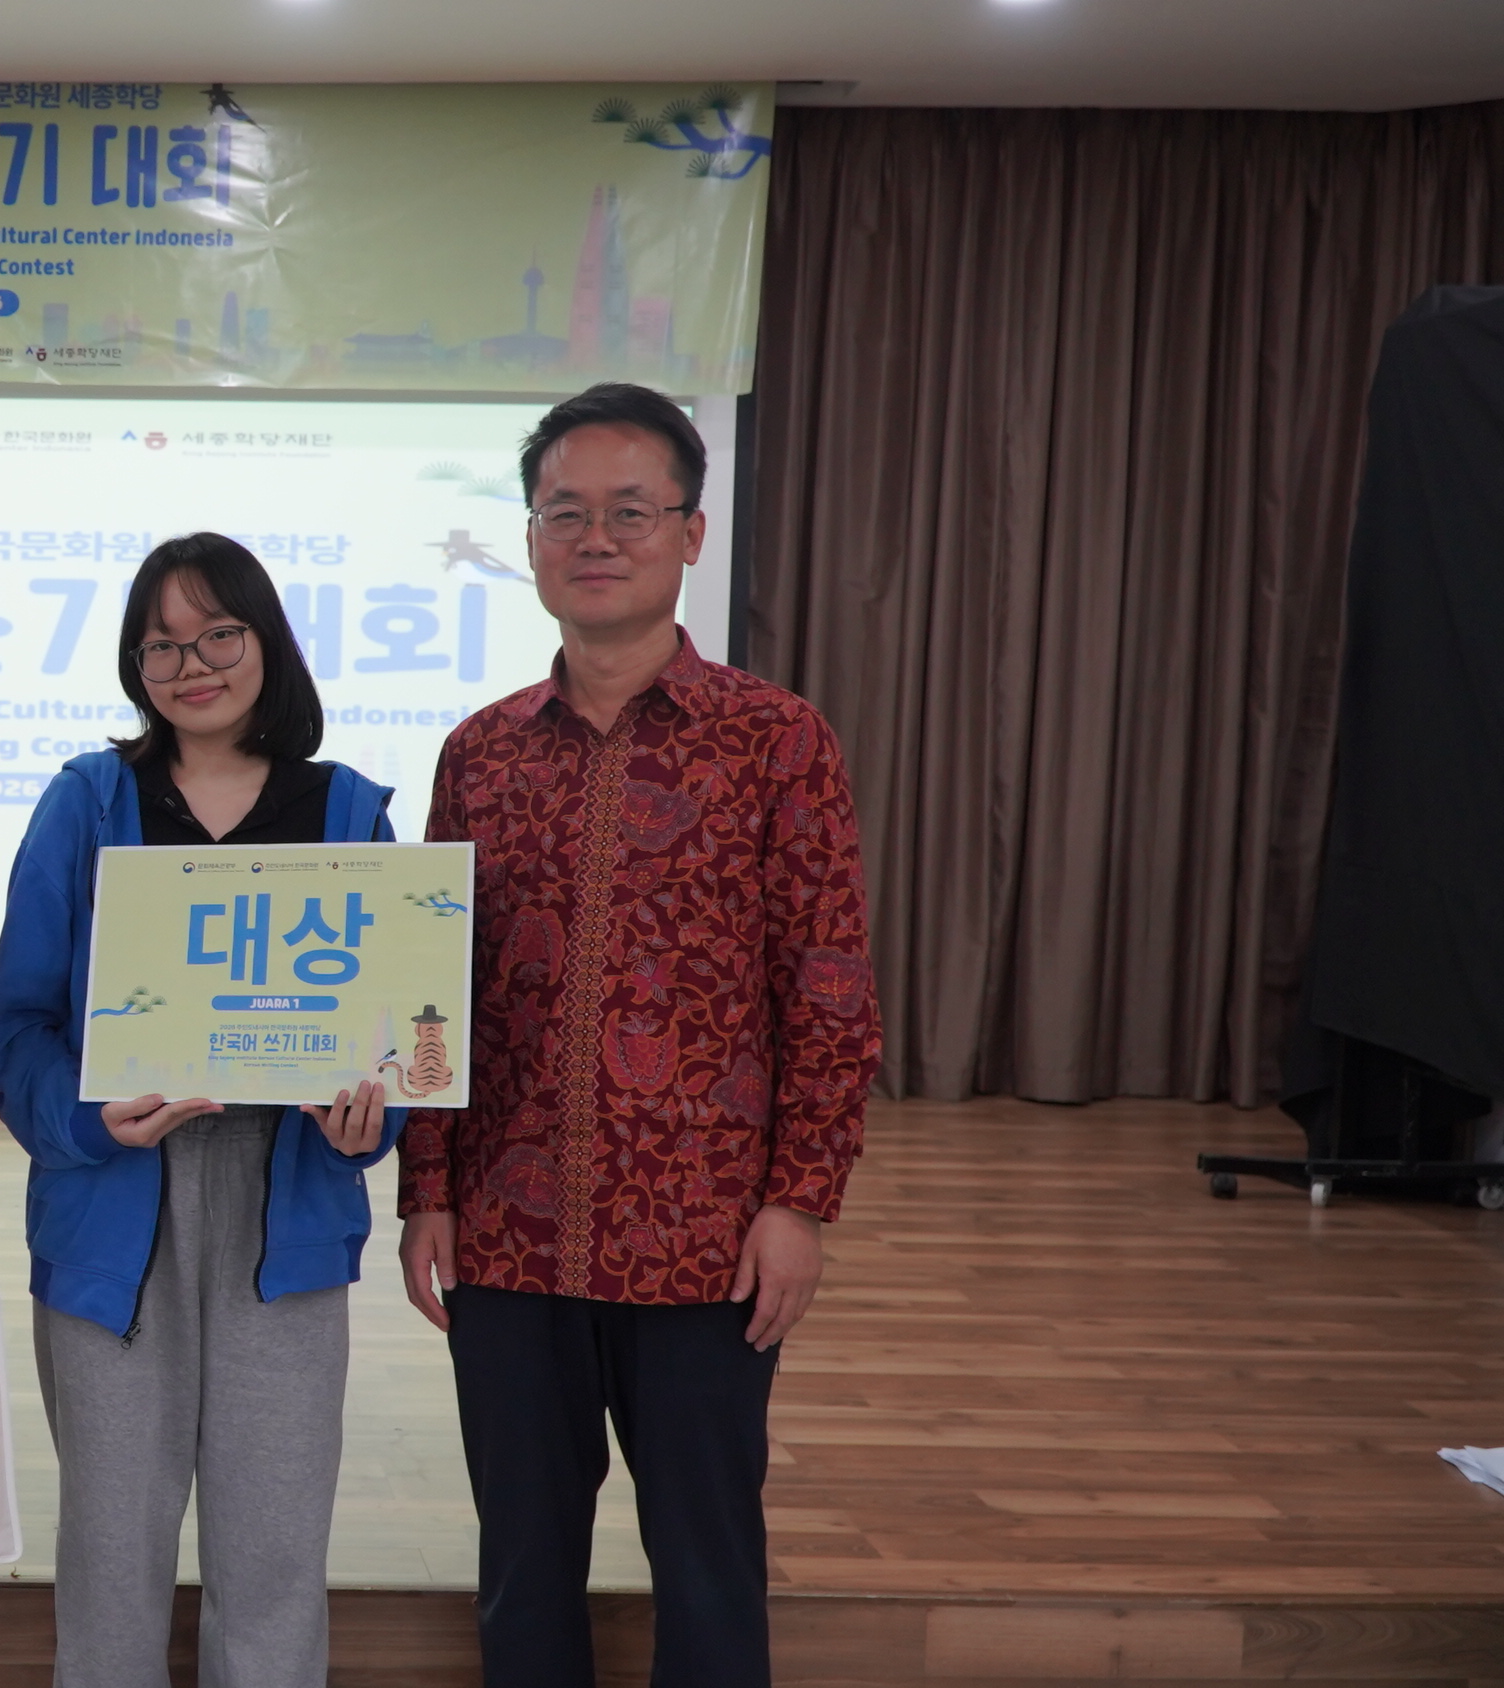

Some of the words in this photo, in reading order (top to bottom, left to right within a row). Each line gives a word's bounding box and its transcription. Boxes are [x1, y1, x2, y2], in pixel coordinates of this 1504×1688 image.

[68, 83, 162, 110] 세종학당
[92, 124, 231, 208] 대회
[63, 228, 129, 246] Center
[136, 228, 233, 247] Indonesia
[4, 430, 92, 443] 한국문화원
[182, 432, 333, 447] 세종학당재단
[187, 892, 374, 986] 대상
[249, 998, 290, 1009] JUARA
[293, 998, 300, 1009] 1
[209, 1033, 257, 1052] 한국어
[263, 1033, 297, 1052] 쓰기
[303, 1034, 337, 1052] 대회
